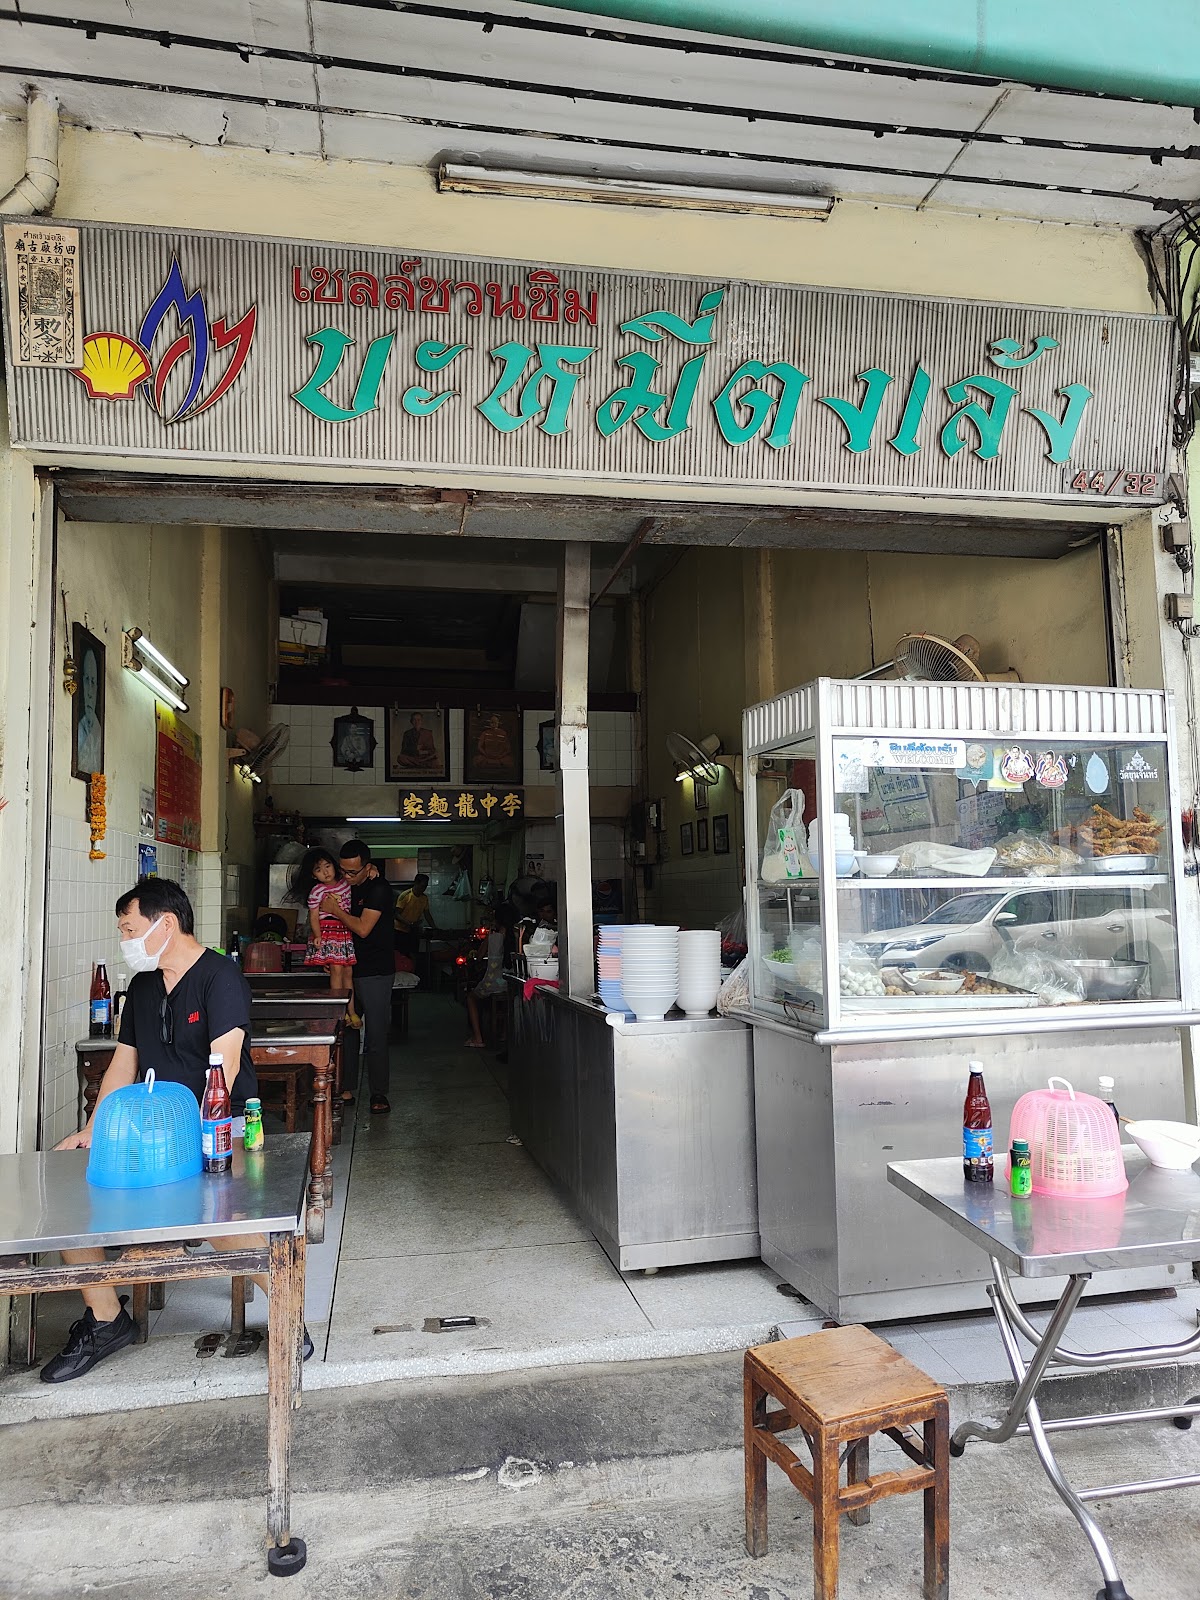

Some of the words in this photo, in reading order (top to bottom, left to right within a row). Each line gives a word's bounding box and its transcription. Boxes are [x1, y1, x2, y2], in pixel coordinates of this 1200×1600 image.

[291, 257, 598, 328] เชลล์ชวนชิม
[290, 286, 1095, 465] บะหมี่ตงเล้ง
[1072, 468, 1157, 496] 44/32
[893, 754, 955, 765] WELCOME
[403, 792, 522, 819] 李中龍麵家
